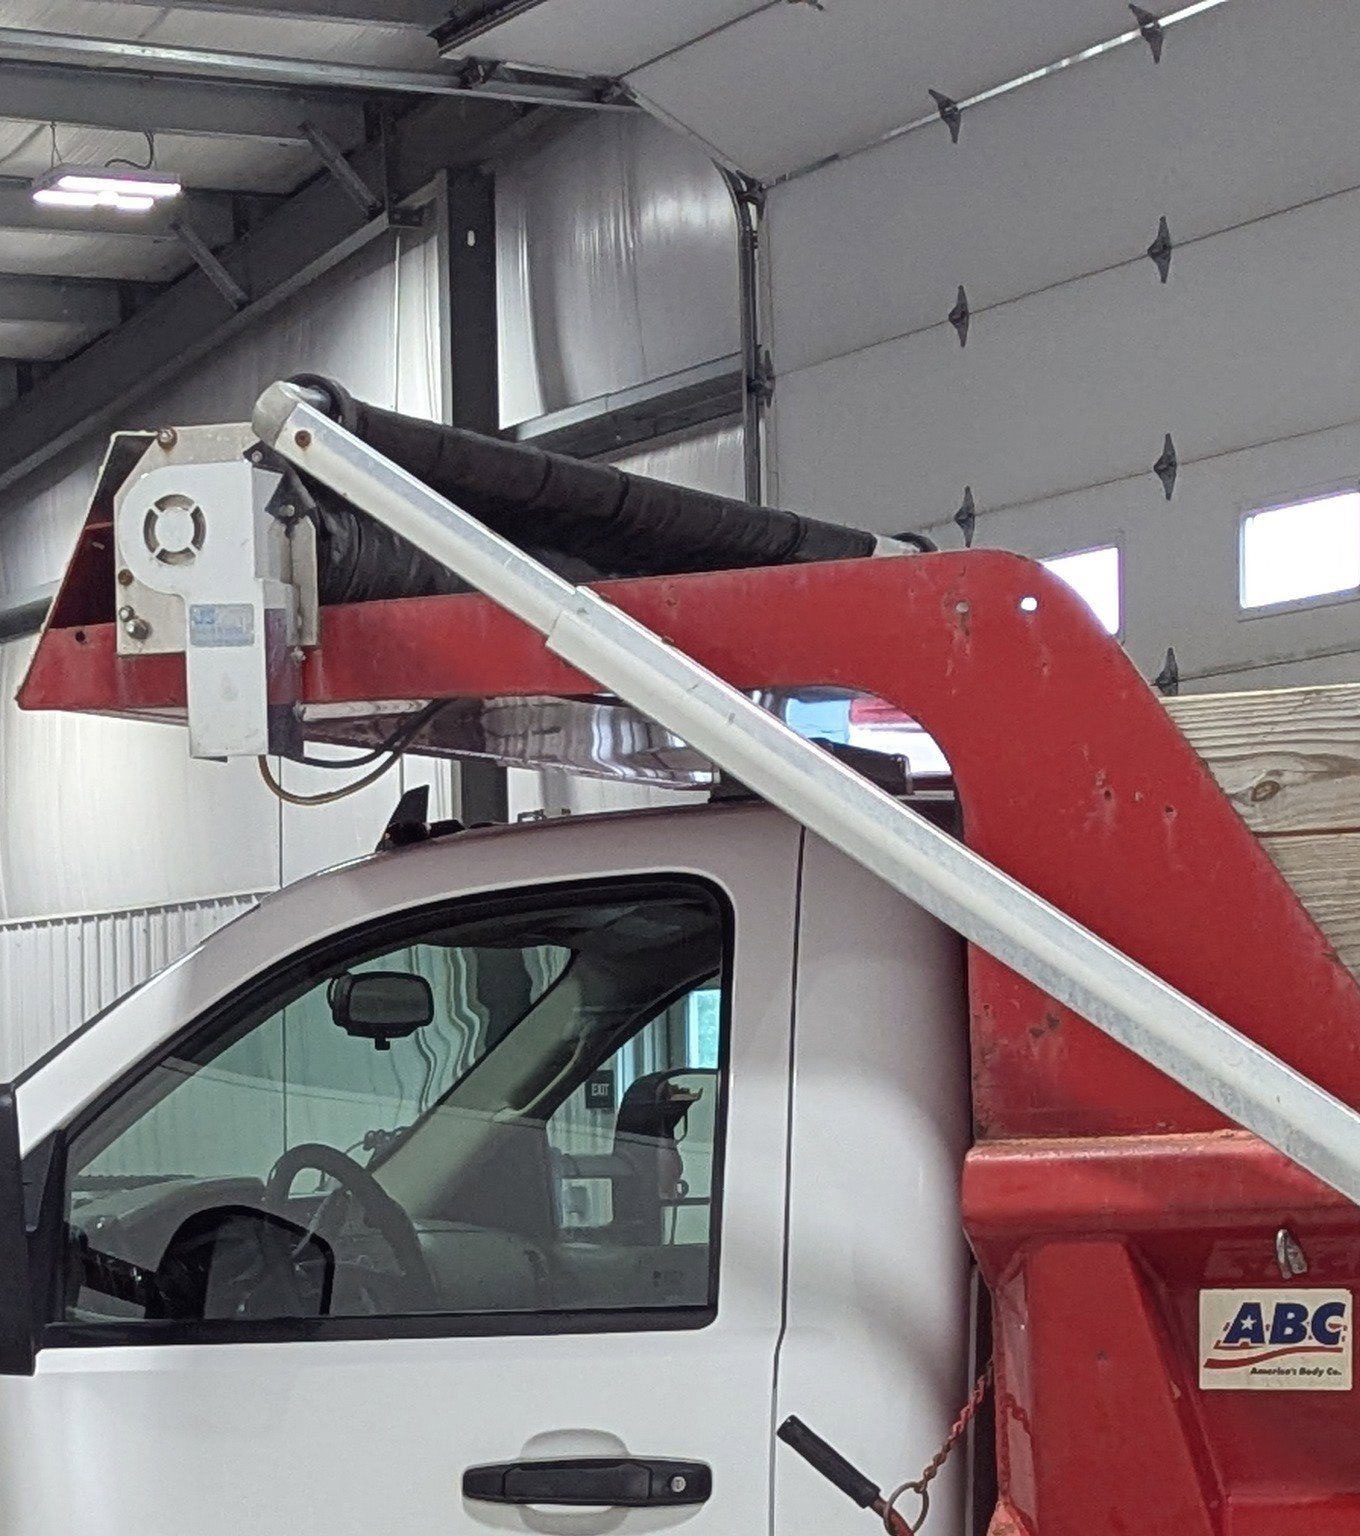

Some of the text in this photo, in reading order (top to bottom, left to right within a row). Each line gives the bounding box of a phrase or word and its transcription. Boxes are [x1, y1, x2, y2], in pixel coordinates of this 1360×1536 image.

[591, 1082, 610, 1097] EXIT
[1223, 1302, 1346, 1345] ABC
[1250, 1366, 1342, 1378] America's Body Co.
